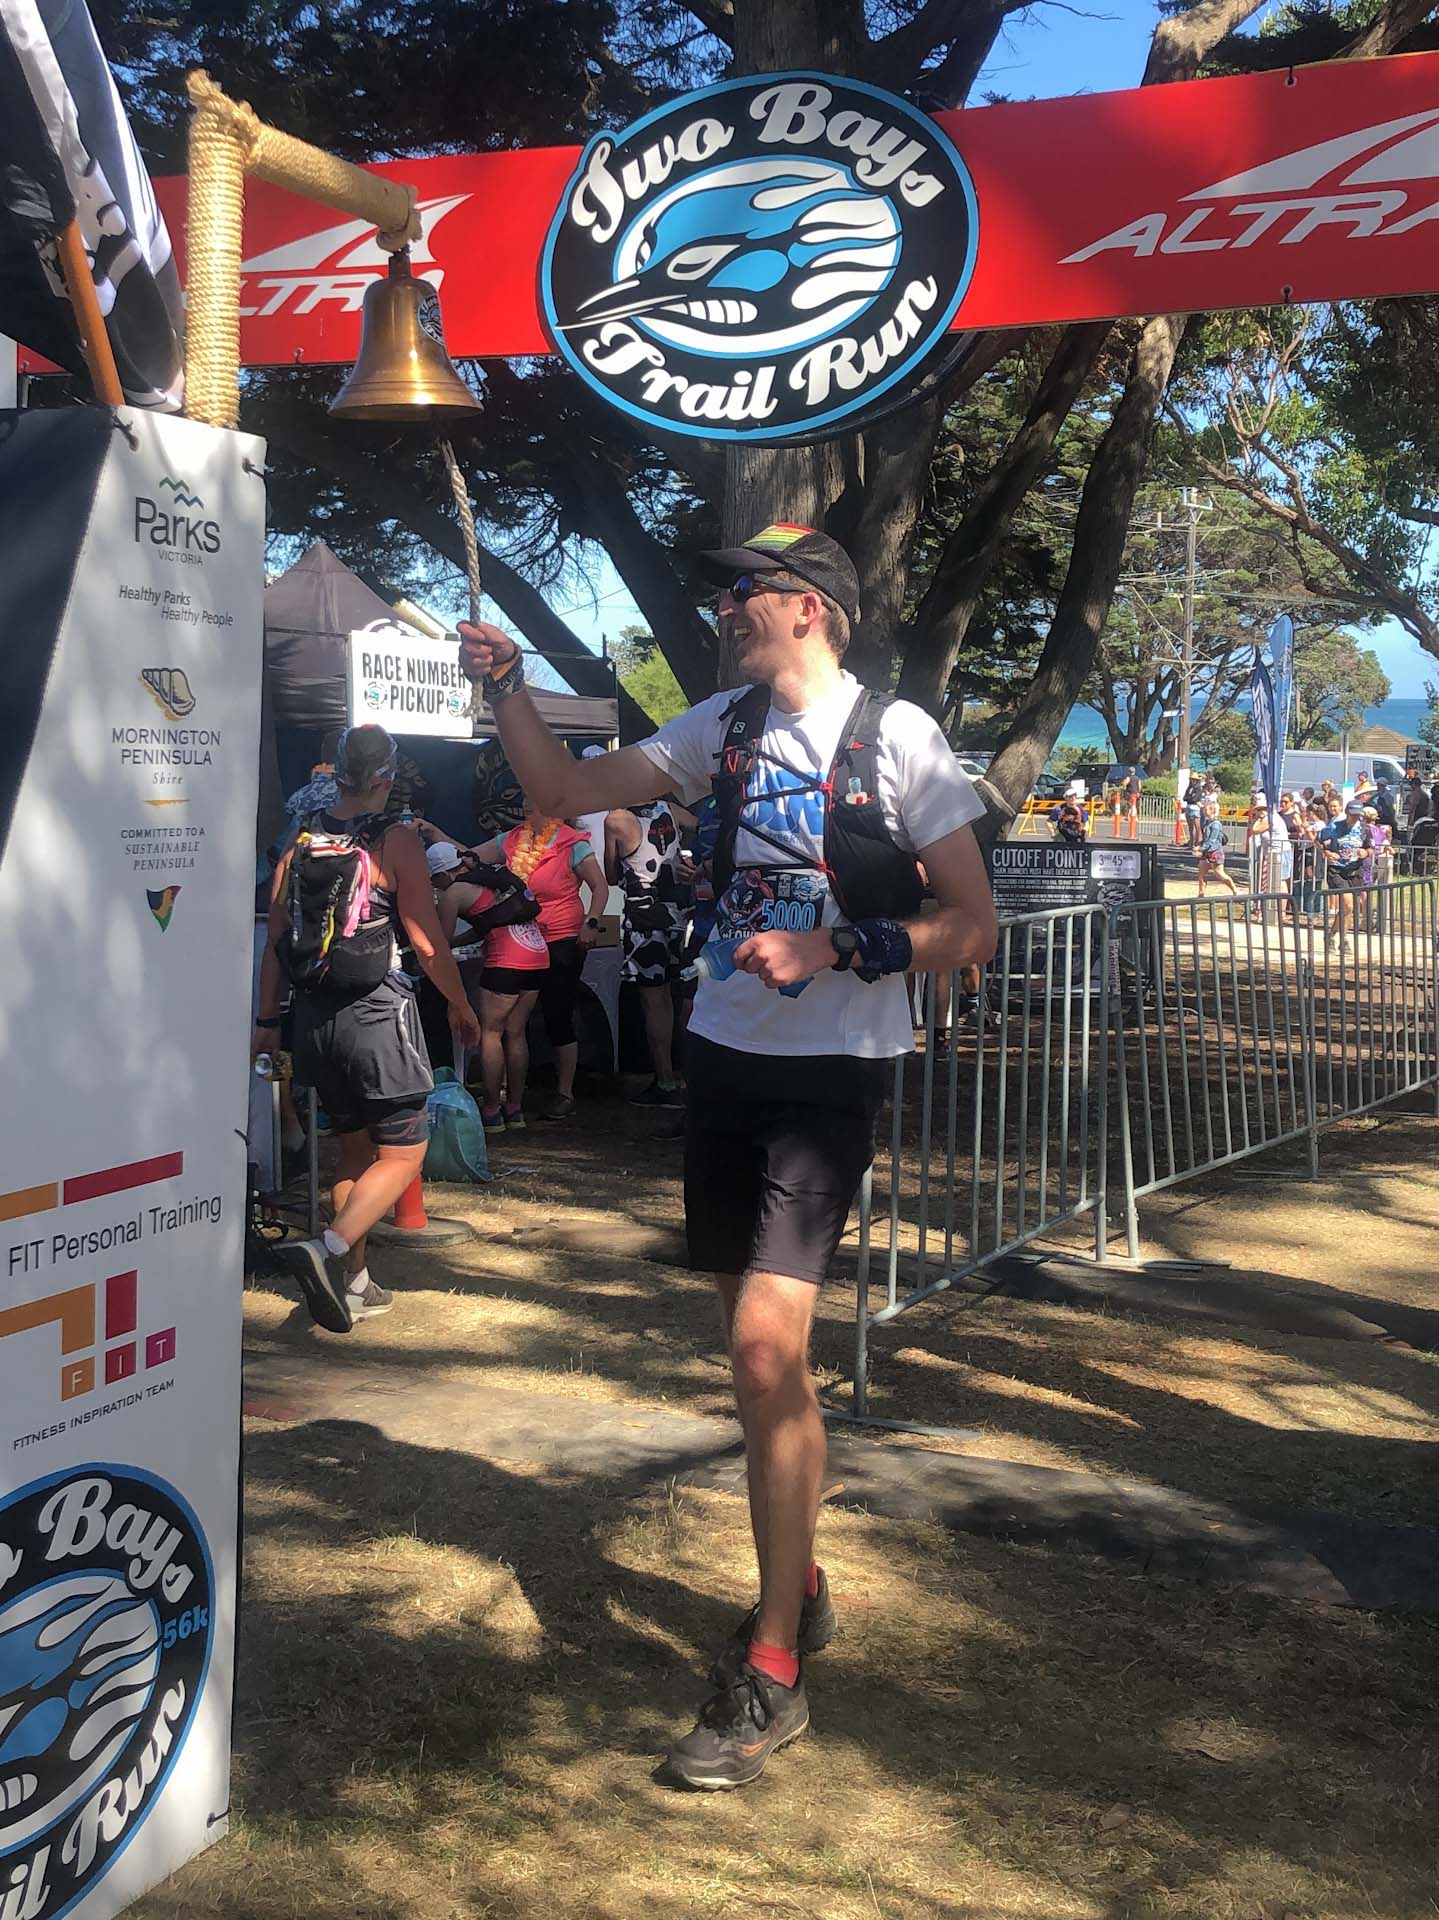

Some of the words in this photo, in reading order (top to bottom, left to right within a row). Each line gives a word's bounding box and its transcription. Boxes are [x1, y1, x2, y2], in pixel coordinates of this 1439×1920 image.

[571, 118, 735, 243] Two
[749, 82, 946, 208] Bays
[582, 321, 779, 421] Trail
[789, 274, 939, 406] Run
[135, 496, 221, 554] Parks
[158, 550, 204, 566] VICTORIA
[119, 585, 162, 607] Healthy
[163, 590, 192, 606] Parks
[161, 608, 200, 626] Healthy
[201, 611, 234, 629] People
[362, 652, 402, 682] RACE
[407, 657, 466, 689] NUMBER
[390, 684, 445, 714] PICKUP
[111, 727, 221, 746] MORNINGTON
[121, 749, 213, 766] PENINSULA
[152, 772, 184, 785] Shire
[120, 828, 182, 839] COMMITTED
[185, 828, 198, 837] TO
[198, 828, 206, 837] A
[125, 842, 201, 855] SUSTAINABLE
[992, 848, 1042, 868] CUTOFF
[1045, 849, 1089, 869] POINT:
[1112, 854, 1123, 866] 45
[133, 857, 195, 871] PENINSULA
[761, 898, 817, 933] 5000
[8, 1239, 45, 1277] FIT
[52, 1212, 143, 1264] Personal
[149, 1195, 222, 1236] Training
[13, 1421, 67, 1451] FITNESS
[70, 1391, 143, 1428] INSPIRATION
[146, 1378, 175, 1398] TEAM
[38, 1477, 195, 1604] Bays
[163, 1605, 210, 1650] 56k
[61, 1678, 186, 1879] Run
